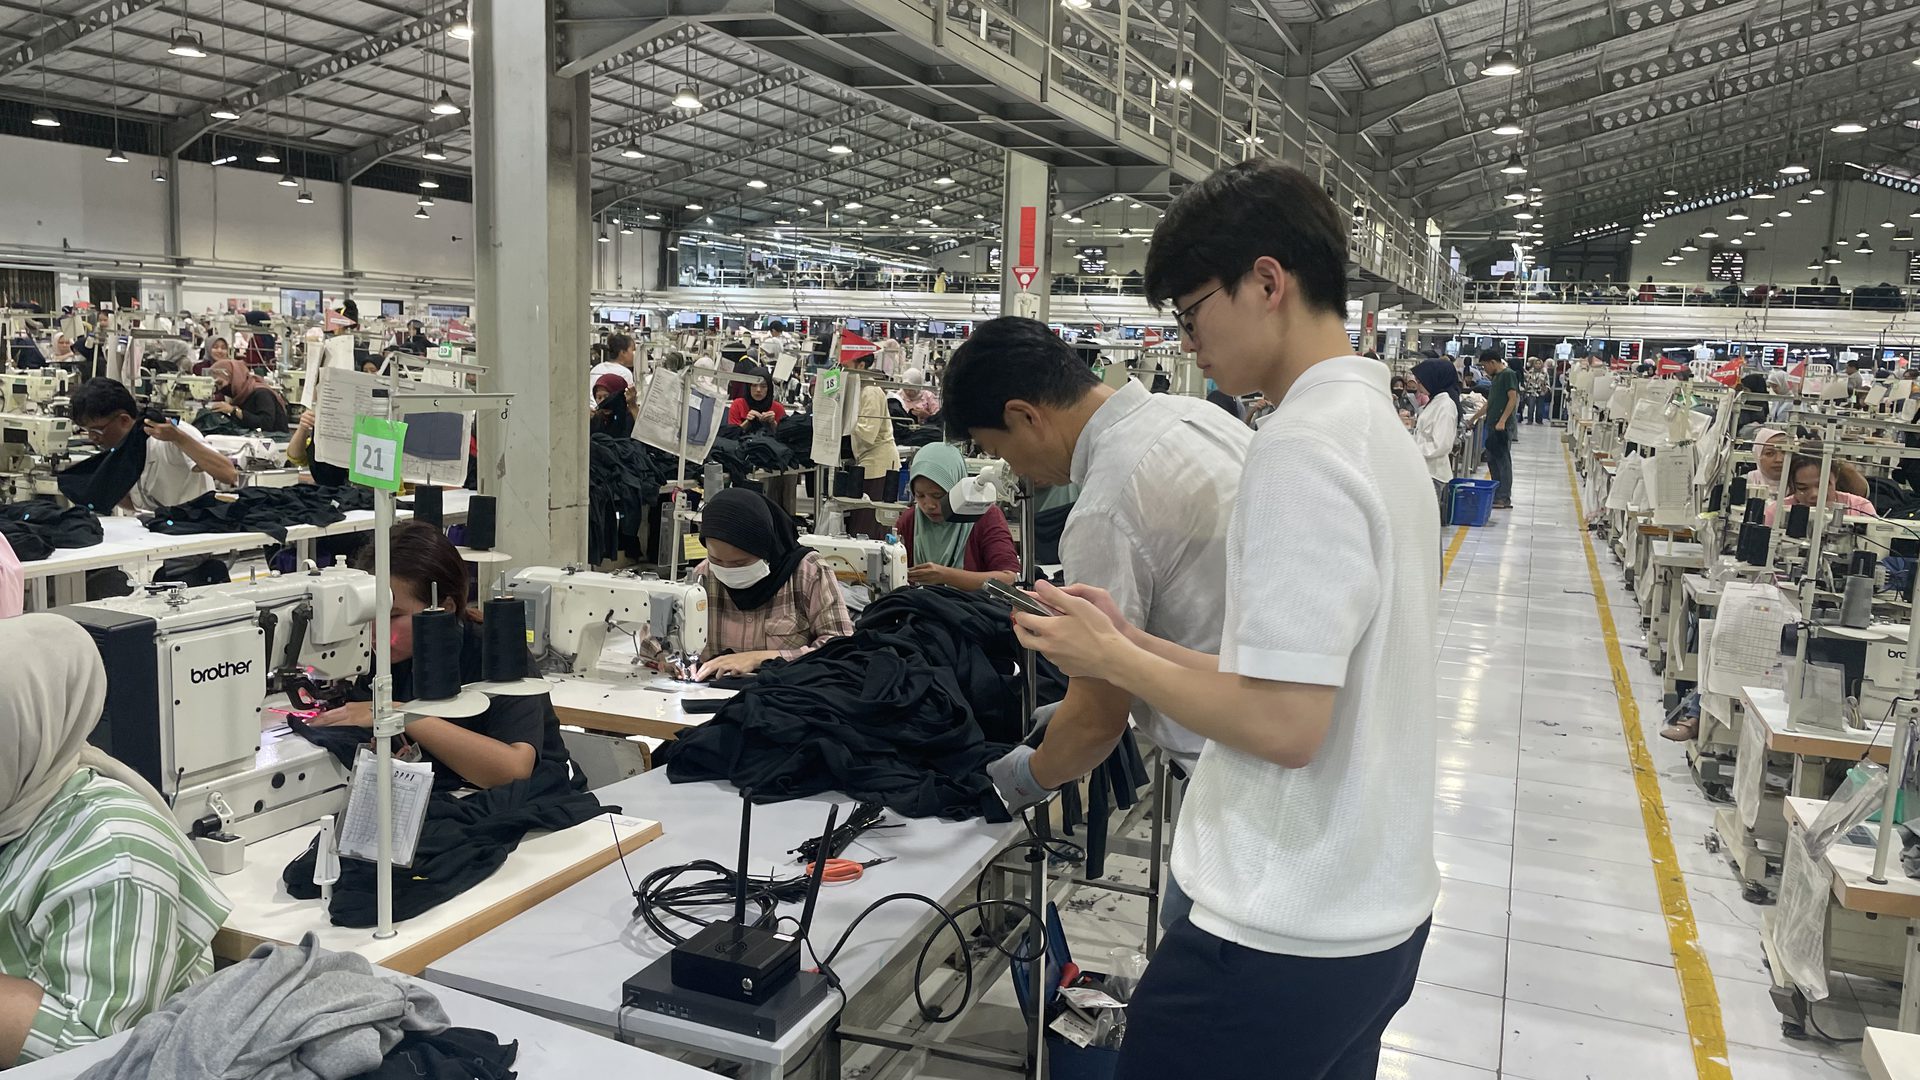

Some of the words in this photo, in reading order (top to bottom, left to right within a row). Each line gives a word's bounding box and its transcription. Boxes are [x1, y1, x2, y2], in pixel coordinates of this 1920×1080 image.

[826, 379, 835, 389] 18
[362, 444, 384, 472] 21
[1887, 648, 1907, 660] bro
[190, 659, 253, 684] brother
